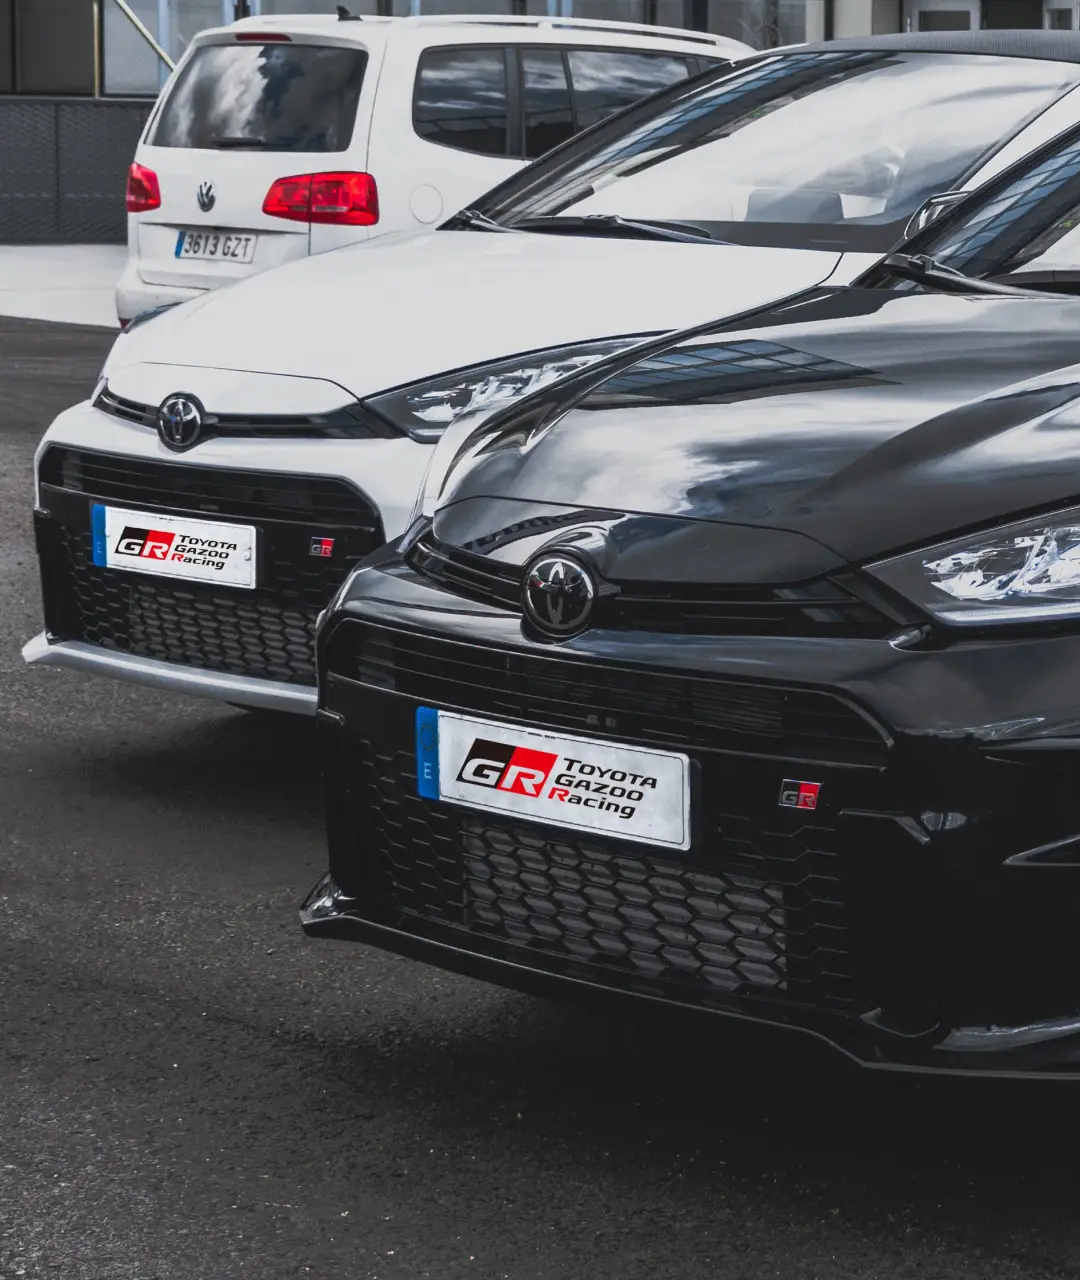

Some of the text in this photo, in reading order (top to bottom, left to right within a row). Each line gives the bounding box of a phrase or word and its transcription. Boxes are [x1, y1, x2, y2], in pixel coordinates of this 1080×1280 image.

[184, 233, 252, 258] 3613 GZT
[116, 537, 170, 560] GR
[174, 544, 229, 560] GAZOO
[179, 534, 237, 551] TOYOTA
[171, 553, 226, 570] Racing
[461, 757, 546, 796] GR
[563, 757, 658, 789] TOYOTA
[554, 773, 644, 802] GAZOO
[781, 790, 816, 807] GR
[547, 786, 636, 819] Racing
